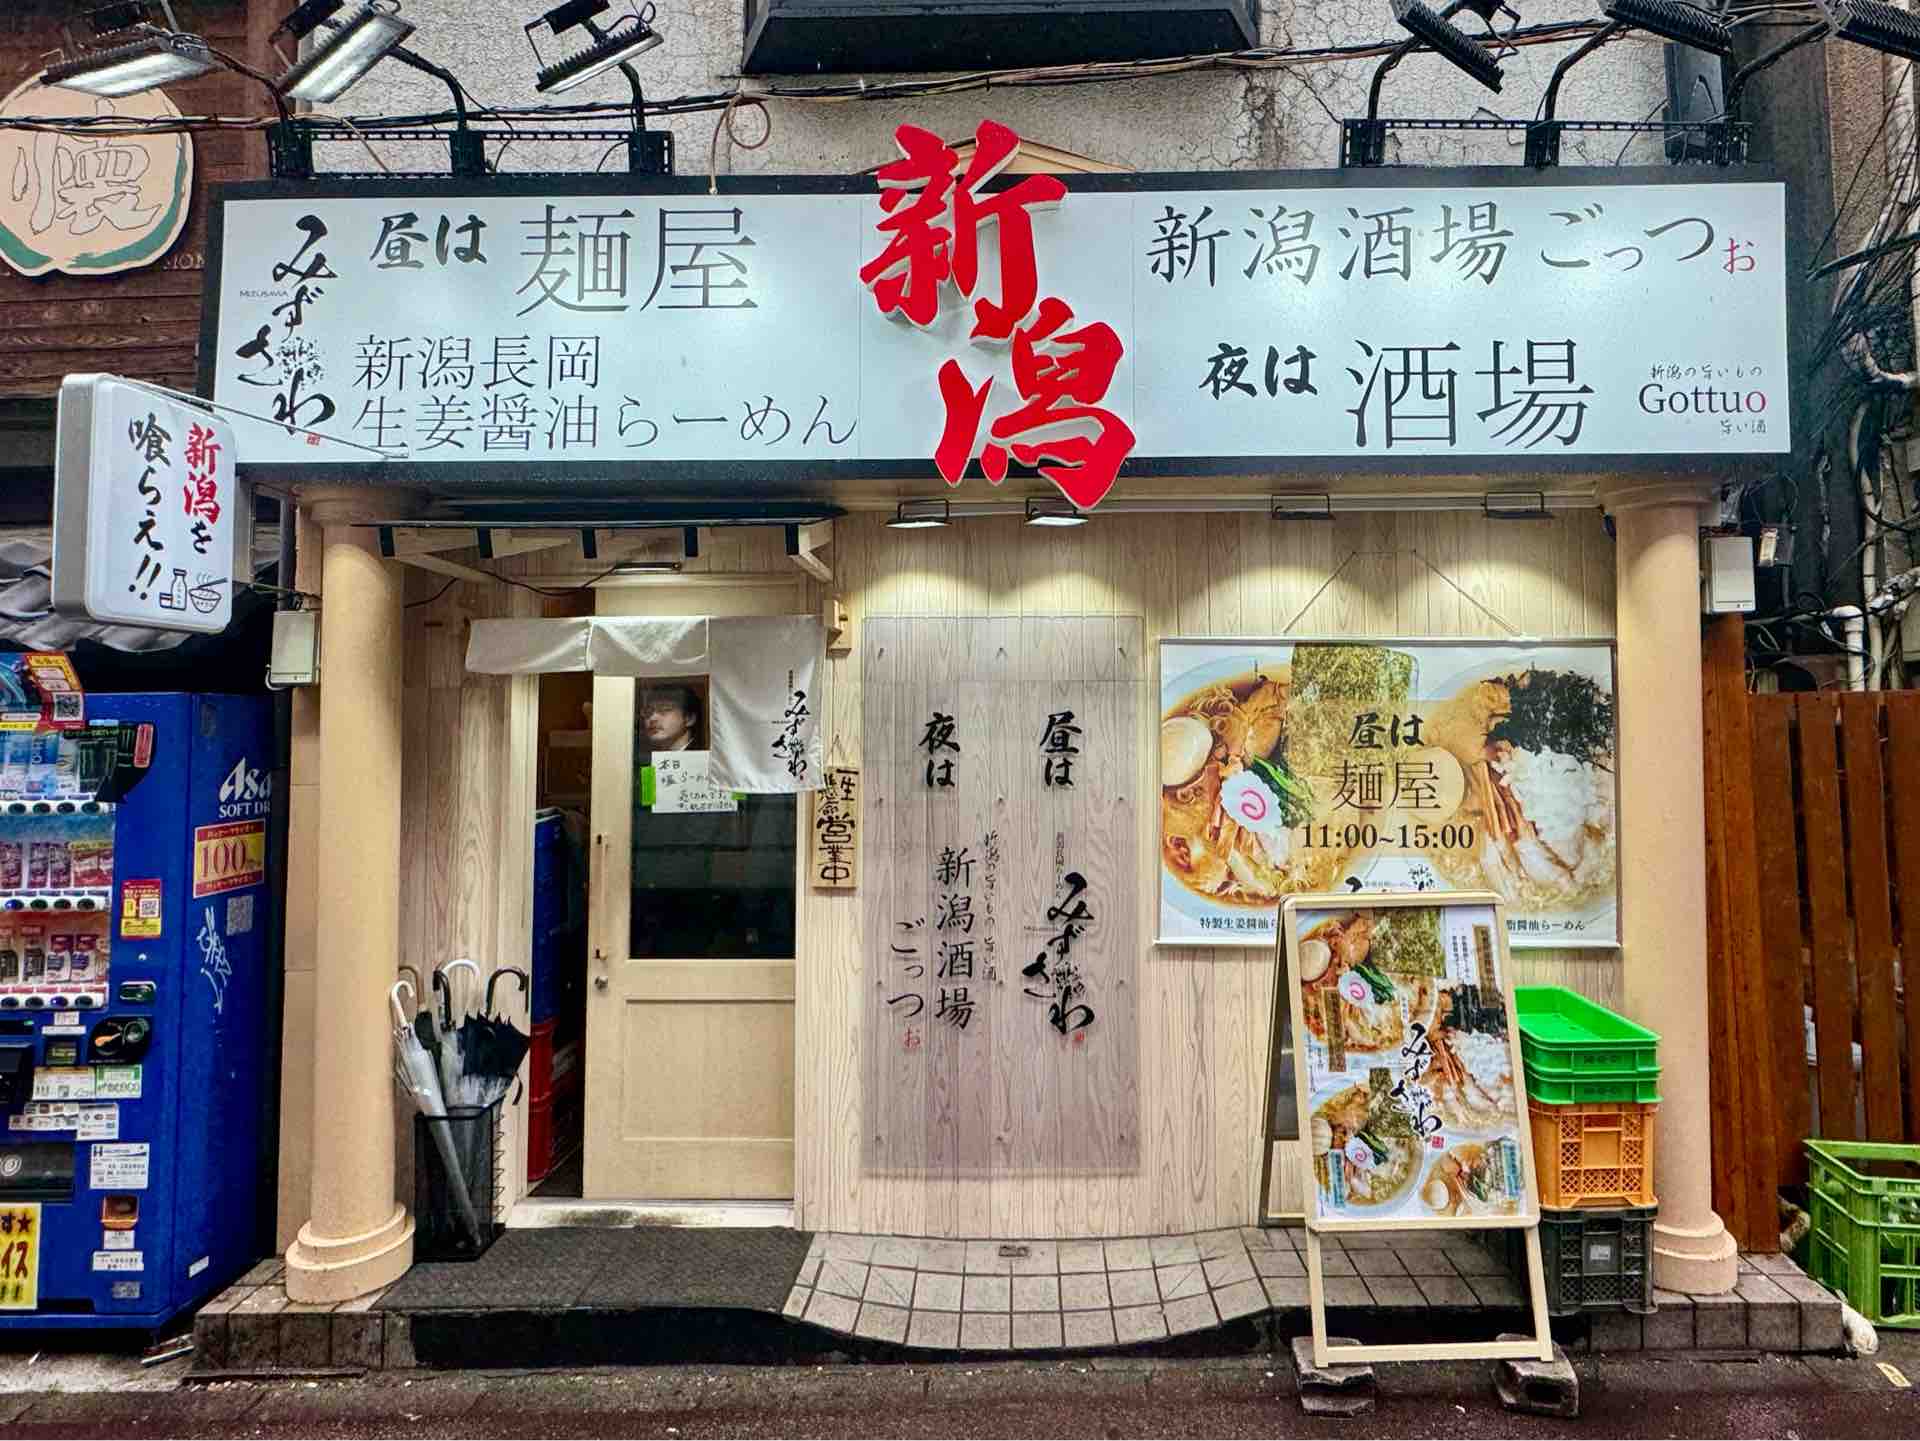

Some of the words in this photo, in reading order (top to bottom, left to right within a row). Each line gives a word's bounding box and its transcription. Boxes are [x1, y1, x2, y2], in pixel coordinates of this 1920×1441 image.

[369, 213, 487, 271] 昼は
[517, 203, 759, 317] 麺屋
[859, 119, 1136, 509] 新潟
[352, 334, 602, 391] 新潟長岡
[1199, 343, 1318, 400] 夜は
[1346, 338, 1596, 449] 酒場
[1638, 382, 1767, 414] Gottuo
[352, 394, 857, 454] 生姜醤油らーめん
[184, 422, 222, 554] 新潟を
[918, 711, 961, 788] 夜は
[1039, 711, 1082, 787] 昼は
[1348, 712, 1425, 750] 昼は
[219, 803, 252, 818] SOFT
[1331, 760, 1441, 811] 麺屋
[935, 846, 977, 1031] 新潟酒場
